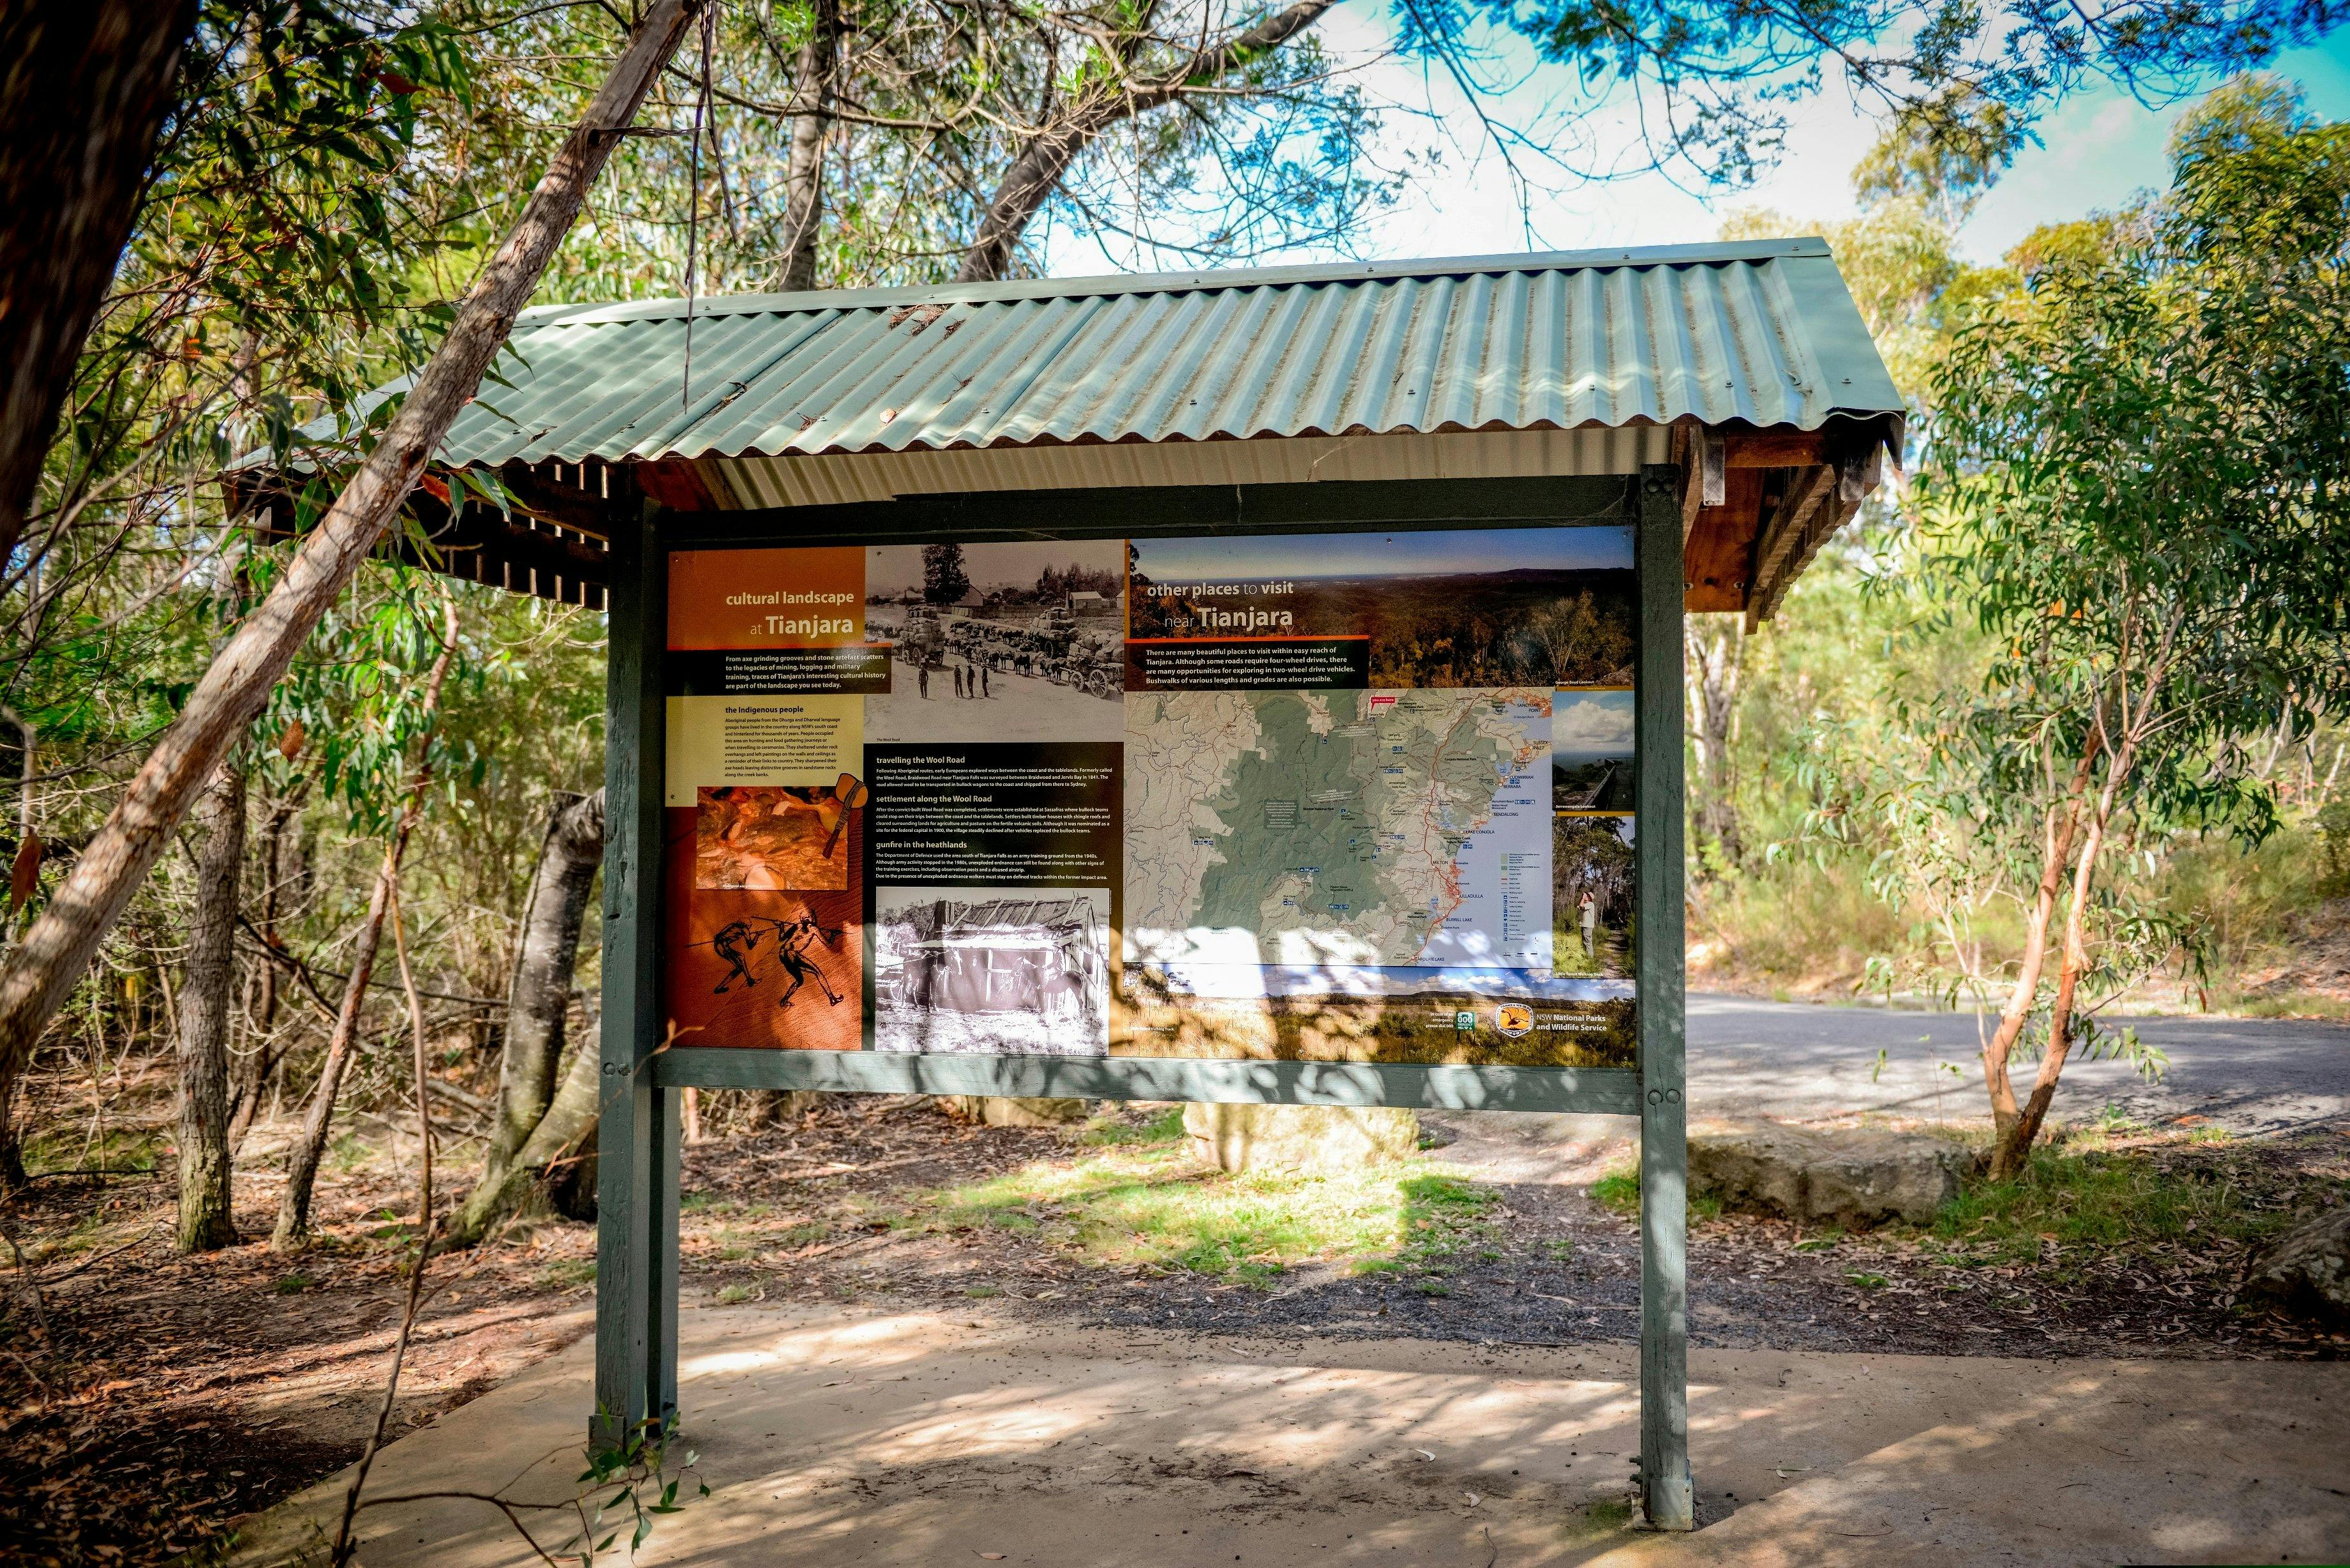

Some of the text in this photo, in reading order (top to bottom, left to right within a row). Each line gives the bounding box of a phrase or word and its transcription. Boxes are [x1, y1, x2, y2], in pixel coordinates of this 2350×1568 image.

[726, 590, 854, 606] cultural landscape
[1147, 580, 1293, 598] other places to visit
[751, 614, 852, 639] at Tianjara
[1165, 607, 1292, 631] near Tianjara
